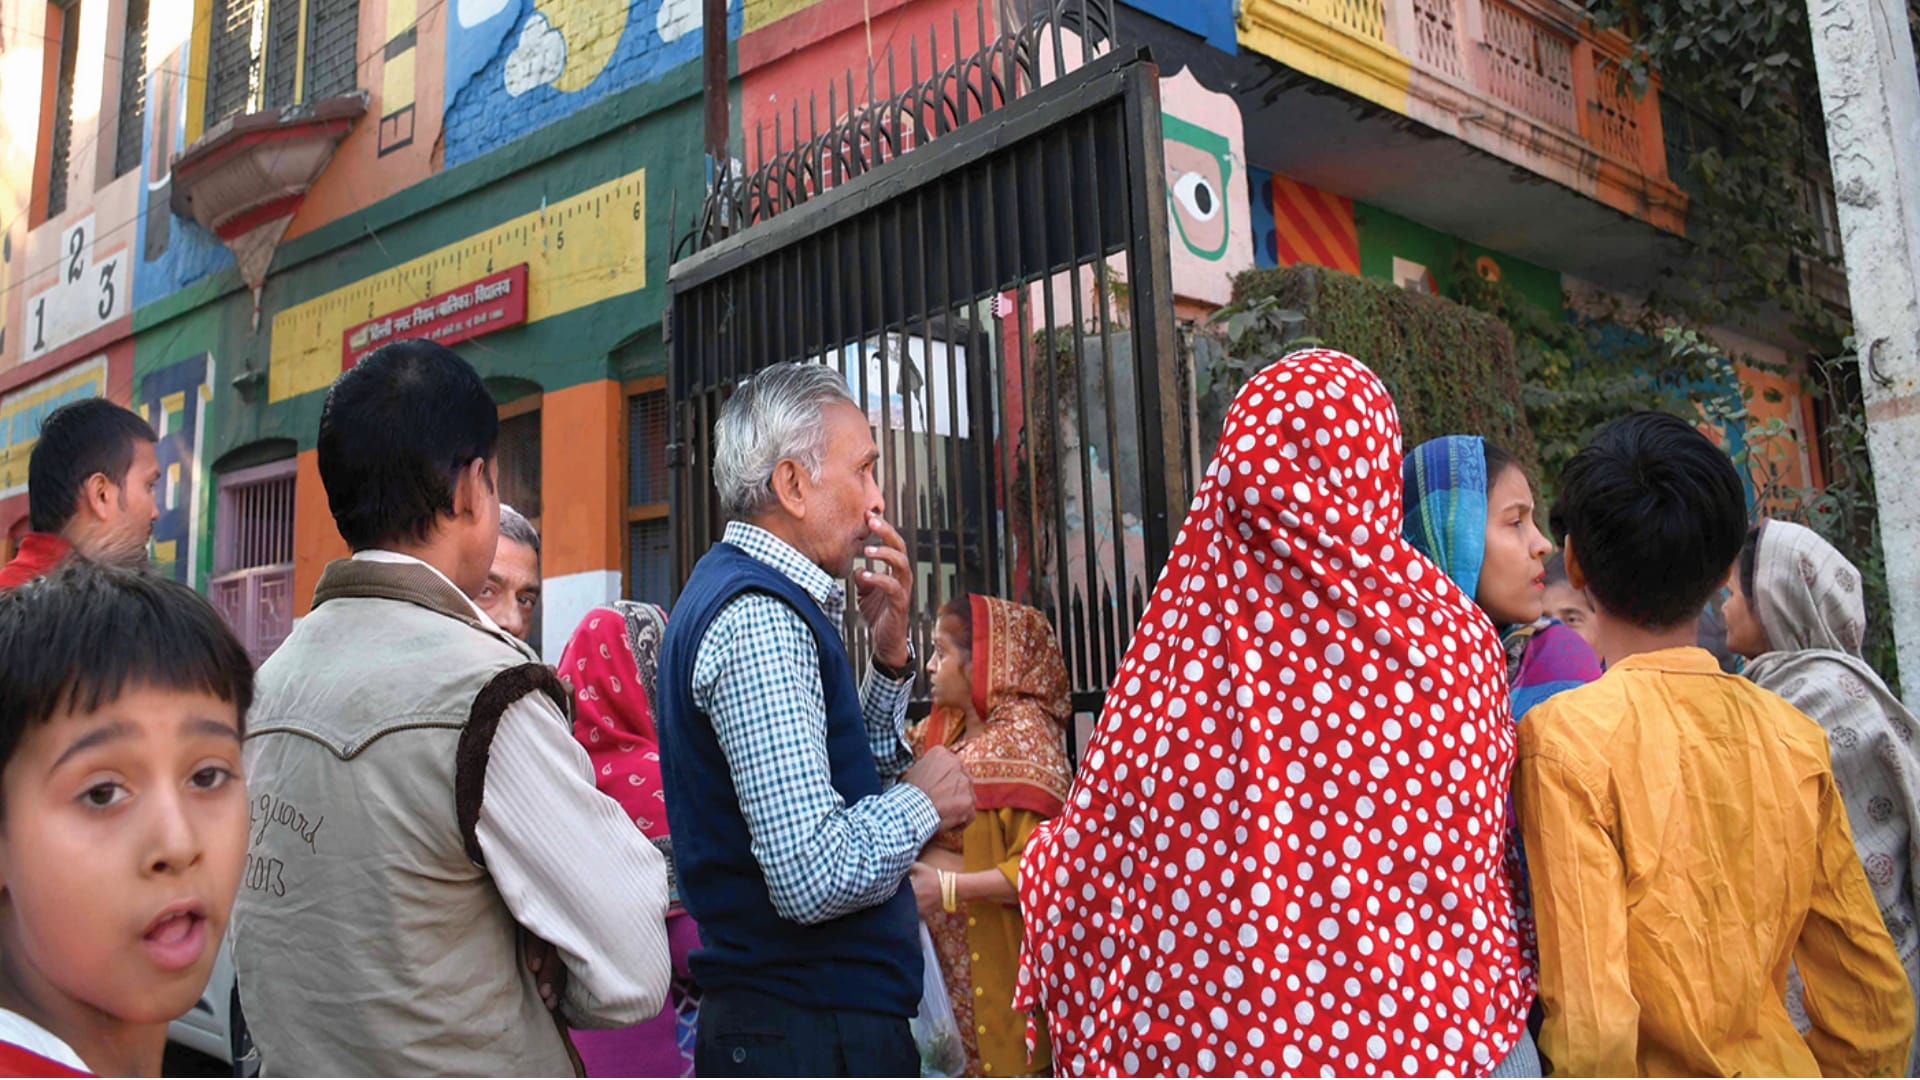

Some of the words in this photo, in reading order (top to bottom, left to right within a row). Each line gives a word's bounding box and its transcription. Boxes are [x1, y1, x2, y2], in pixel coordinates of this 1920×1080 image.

[68, 226, 85, 285] 2
[368, 302, 375, 318] 2
[425, 281, 432, 299] 3
[486, 258, 494, 274] 4
[556, 231, 565, 250] 5
[633, 201, 641, 221] 6
[98, 260, 117, 320] 3
[33, 297, 45, 352] 1
[245, 853, 286, 897] 2013
